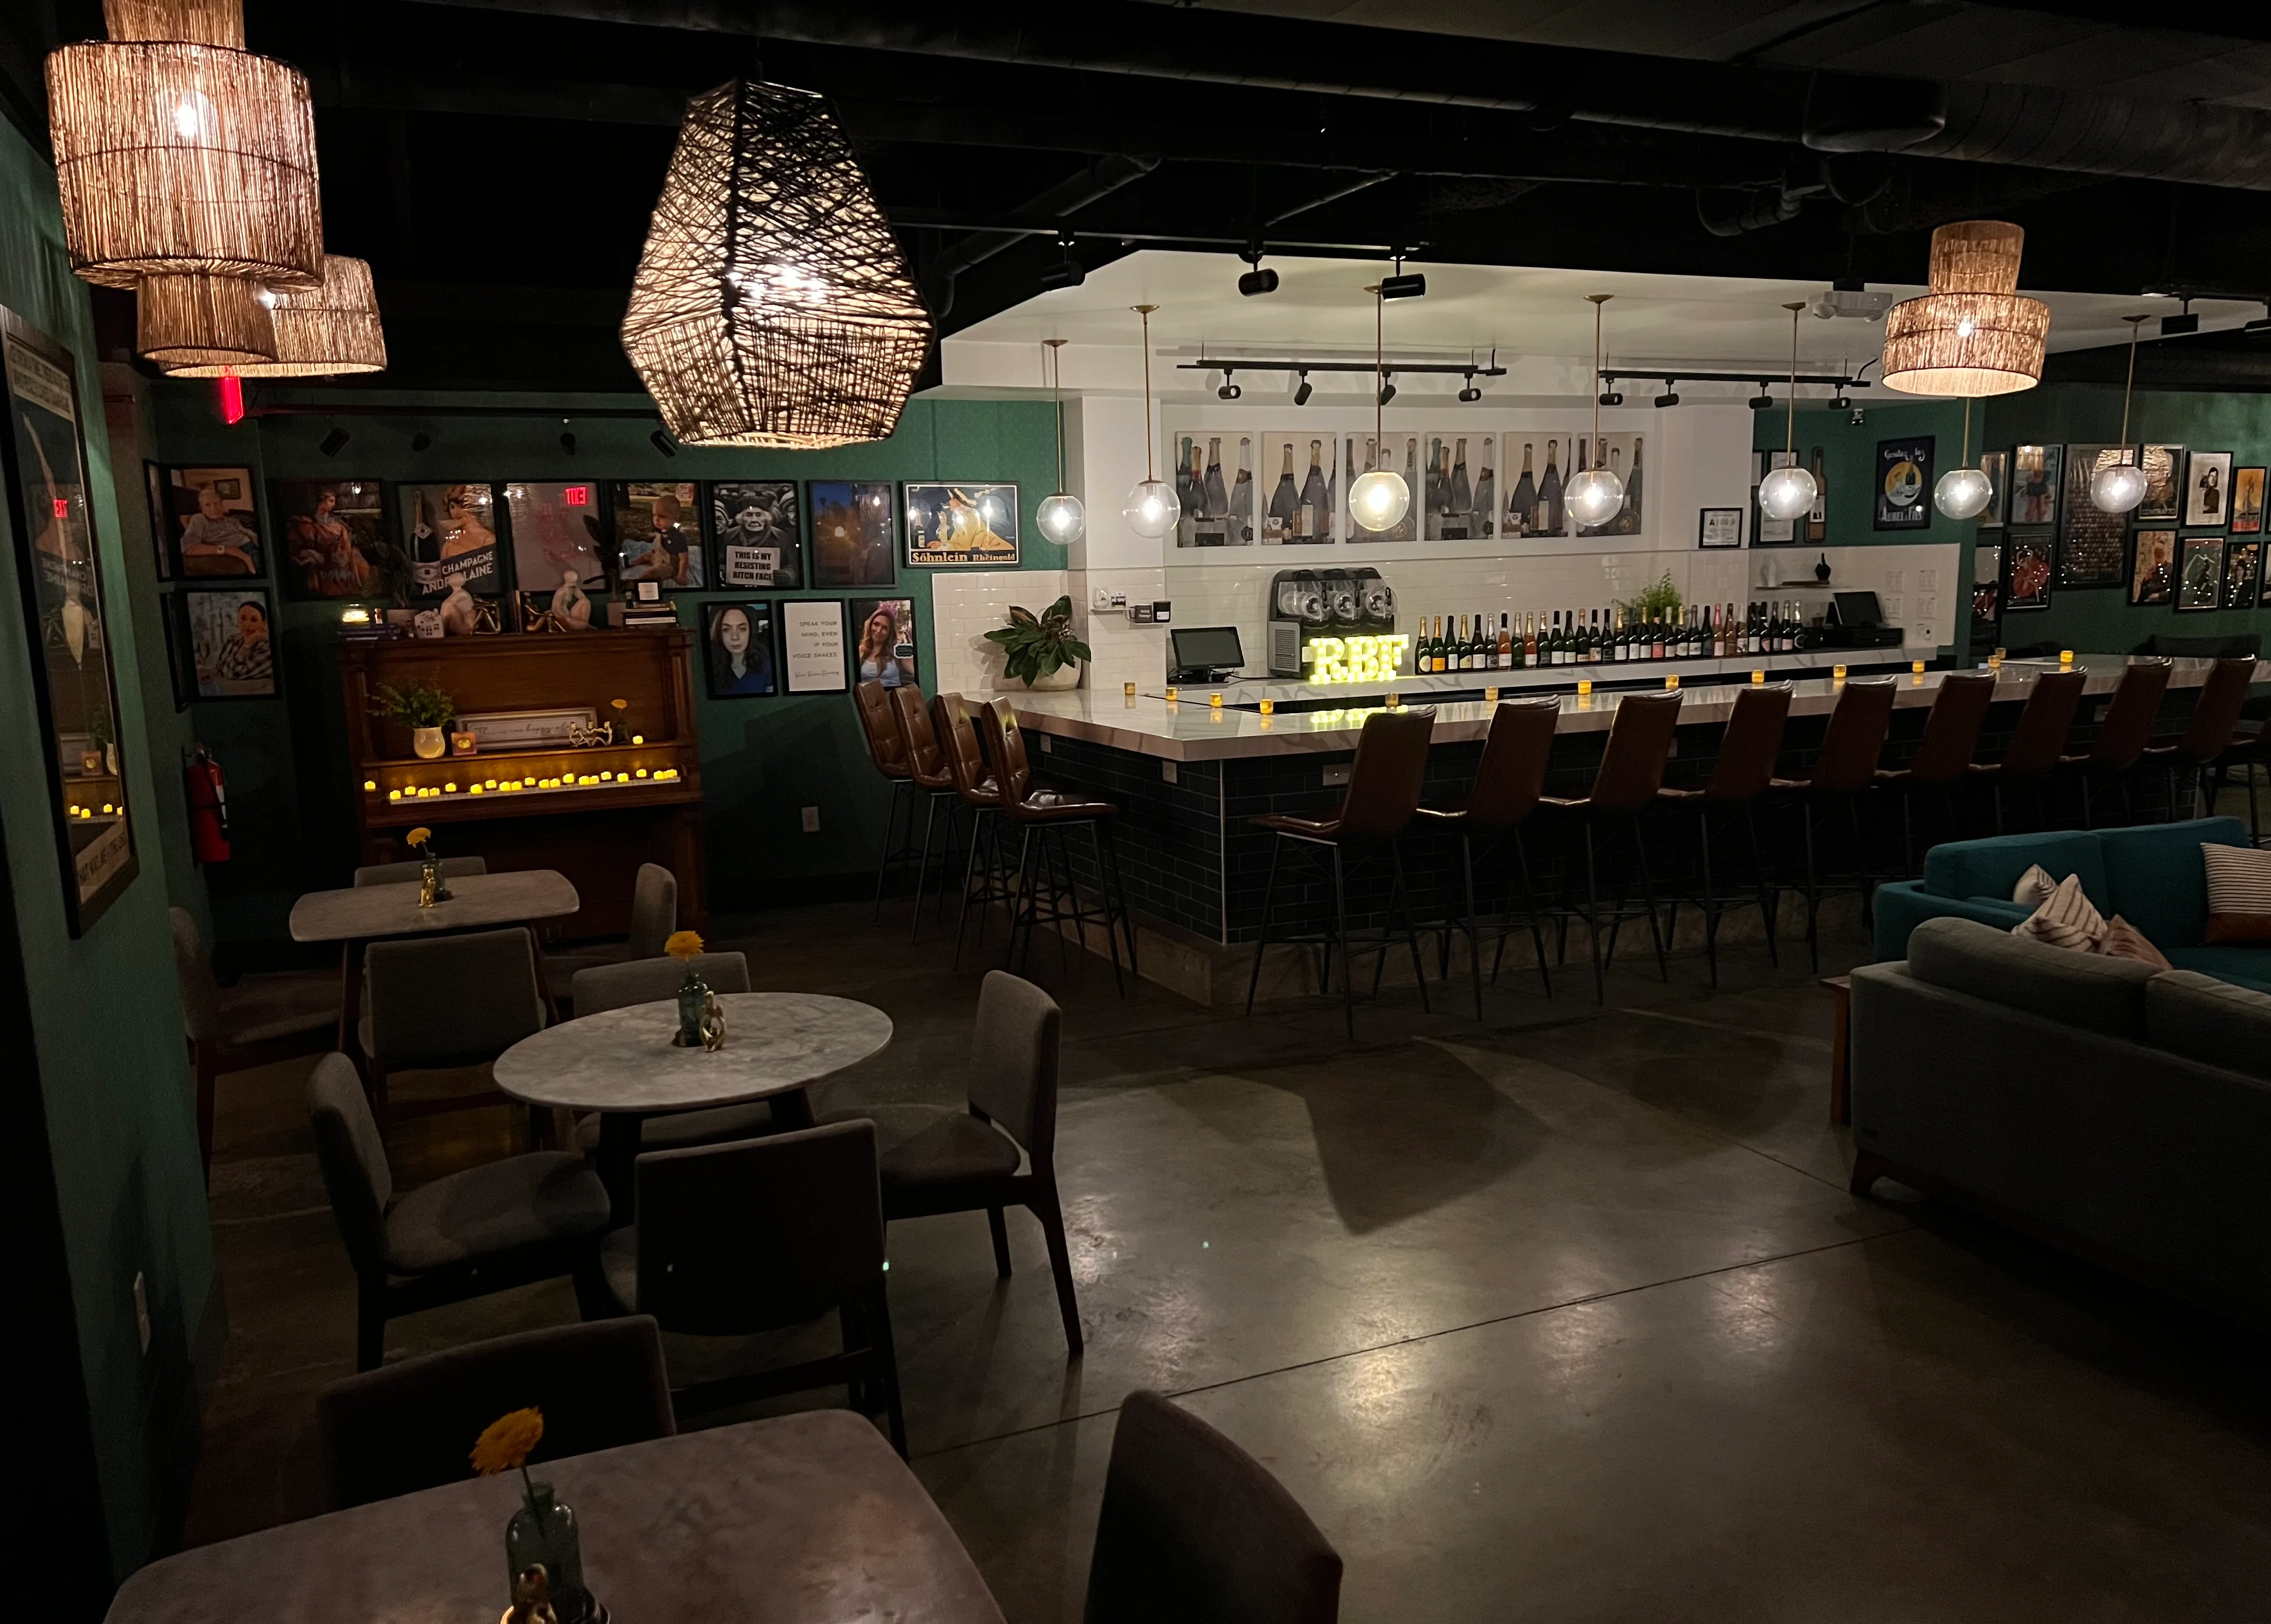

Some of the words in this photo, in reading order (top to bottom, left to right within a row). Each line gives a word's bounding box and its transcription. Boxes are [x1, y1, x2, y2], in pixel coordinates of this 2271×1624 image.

[442, 550, 493, 575] CHAMPAGNE
[734, 562, 771, 570] RESISTING
[912, 551, 968, 562] Söhnlein
[973, 553, 1015, 562] Rheingold
[421, 576, 449, 595] ANDR
[1310, 634, 1409, 685] RBF
